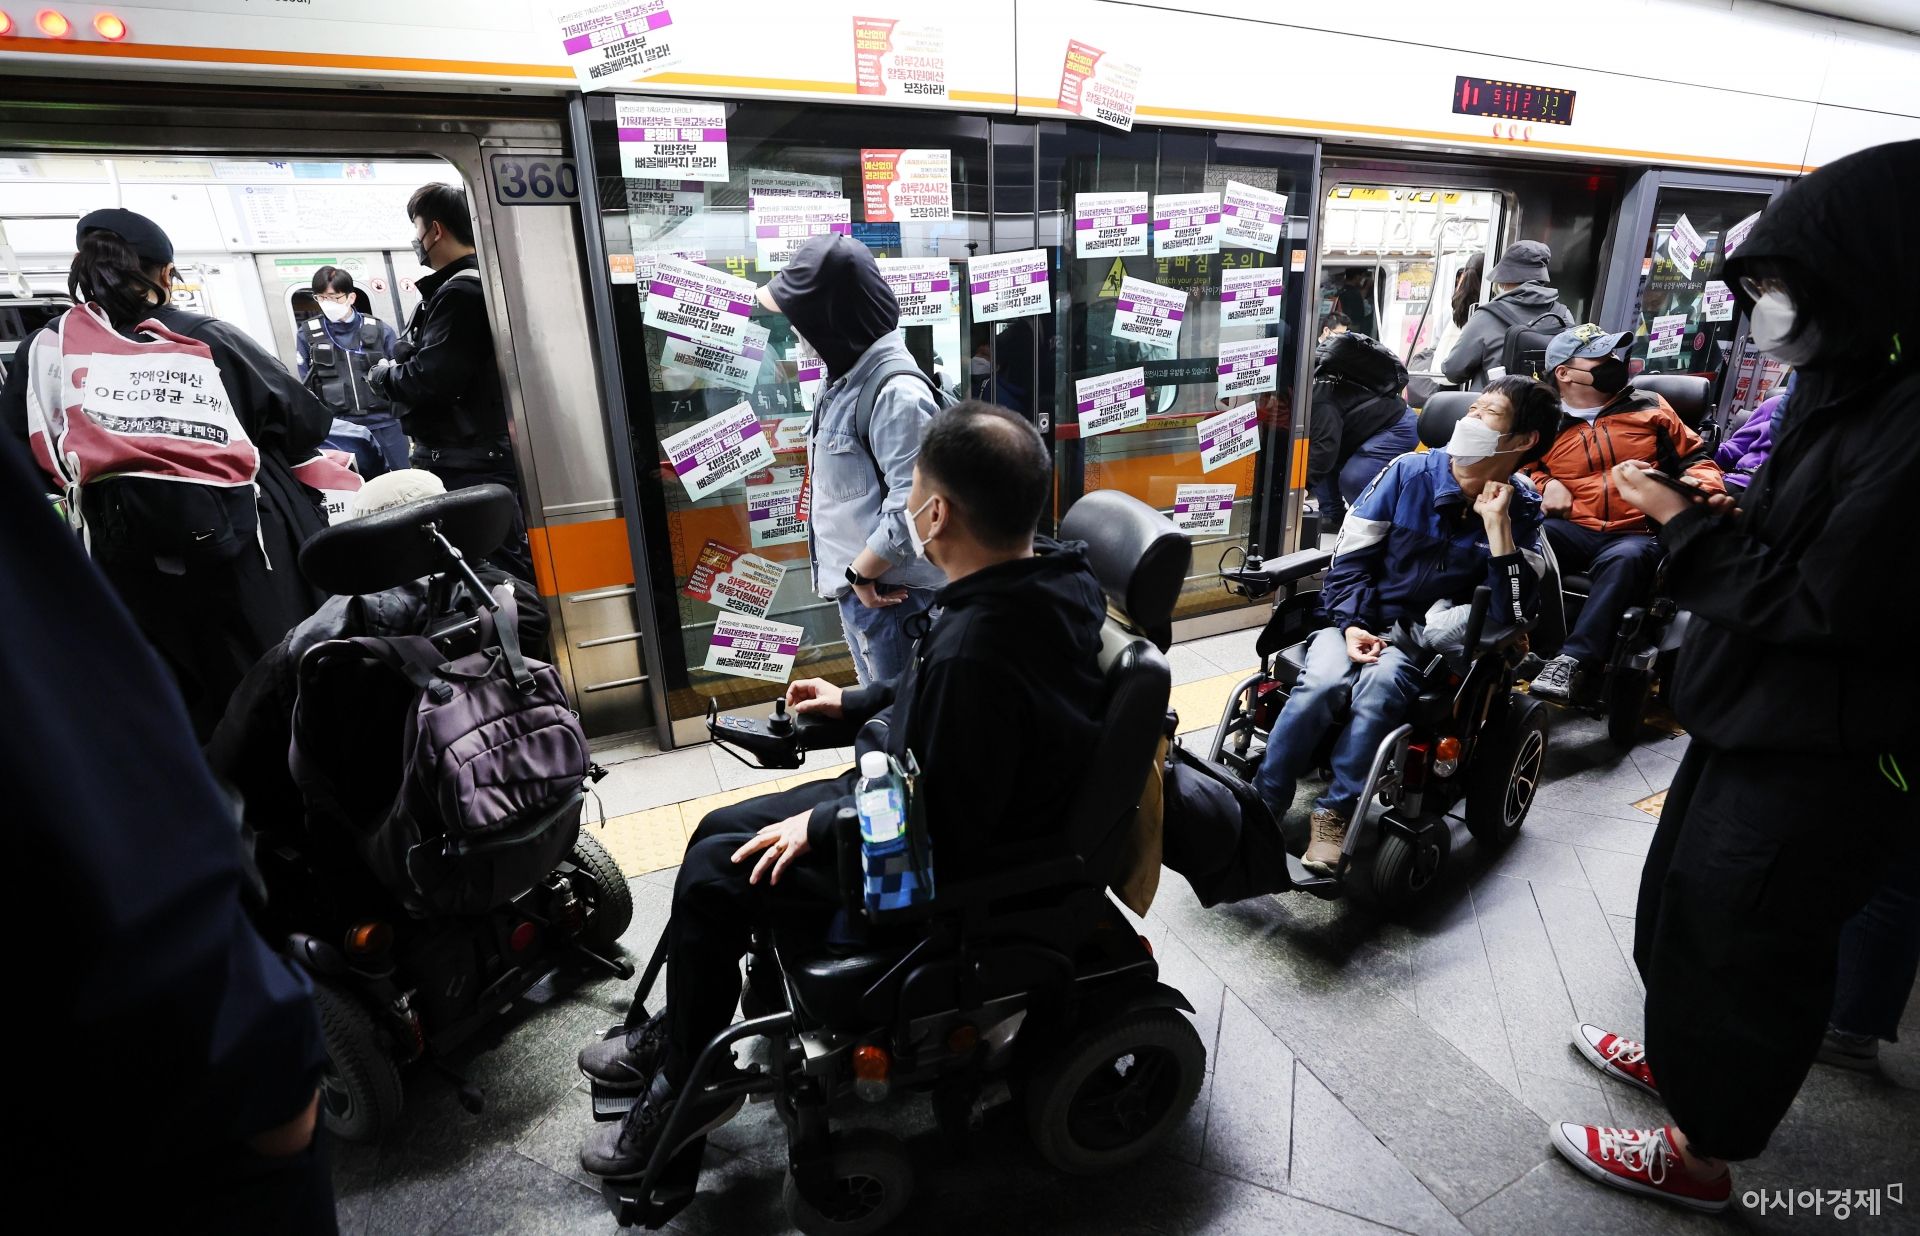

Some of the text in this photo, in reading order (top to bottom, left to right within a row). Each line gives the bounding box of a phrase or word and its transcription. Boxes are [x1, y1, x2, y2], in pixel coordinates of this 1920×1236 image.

[904, 82, 944, 95] 보장하라!
[620, 117, 723, 126] 기획재정부는 특별교통수단
[1096, 107, 1130, 126] 보장하라!
[654, 144, 696, 155] 지방정부
[692, 157, 716, 168] 말라!
[865, 161, 893, 170] 예산없이
[501, 163, 580, 198] 360
[865, 171, 894, 180] 권리없다
[901, 183, 948, 193] 하루24시간
[632, 191, 674, 203] 지방정부
[894, 195, 948, 206] 활동지원예산
[910, 207, 949, 217] 보장하라!
[1222, 253, 1264, 269] 주의!
[655, 272, 753, 303] 기획재정부는 특별교통수단
[677, 302, 720, 322] 지방정부
[710, 322, 736, 337] 말라!
[695, 347, 735, 364] 지방정부
[130, 370, 204, 388] 장애인예산
[1170, 369, 1184, 377] 유발할
[95, 387, 222, 412] OECD평균 보장!
[672, 401, 692, 413] 7-1
[768, 504, 796, 518] 운영비
[728, 576, 773, 598] 하루24시간
[716, 583, 769, 608] 활동지원예산
[726, 597, 765, 618] 보장하라!
[716, 627, 800, 644] 기획재정부는 특별교통수단
[734, 650, 771, 661] 지방정부
[761, 662, 784, 672] 말라!
